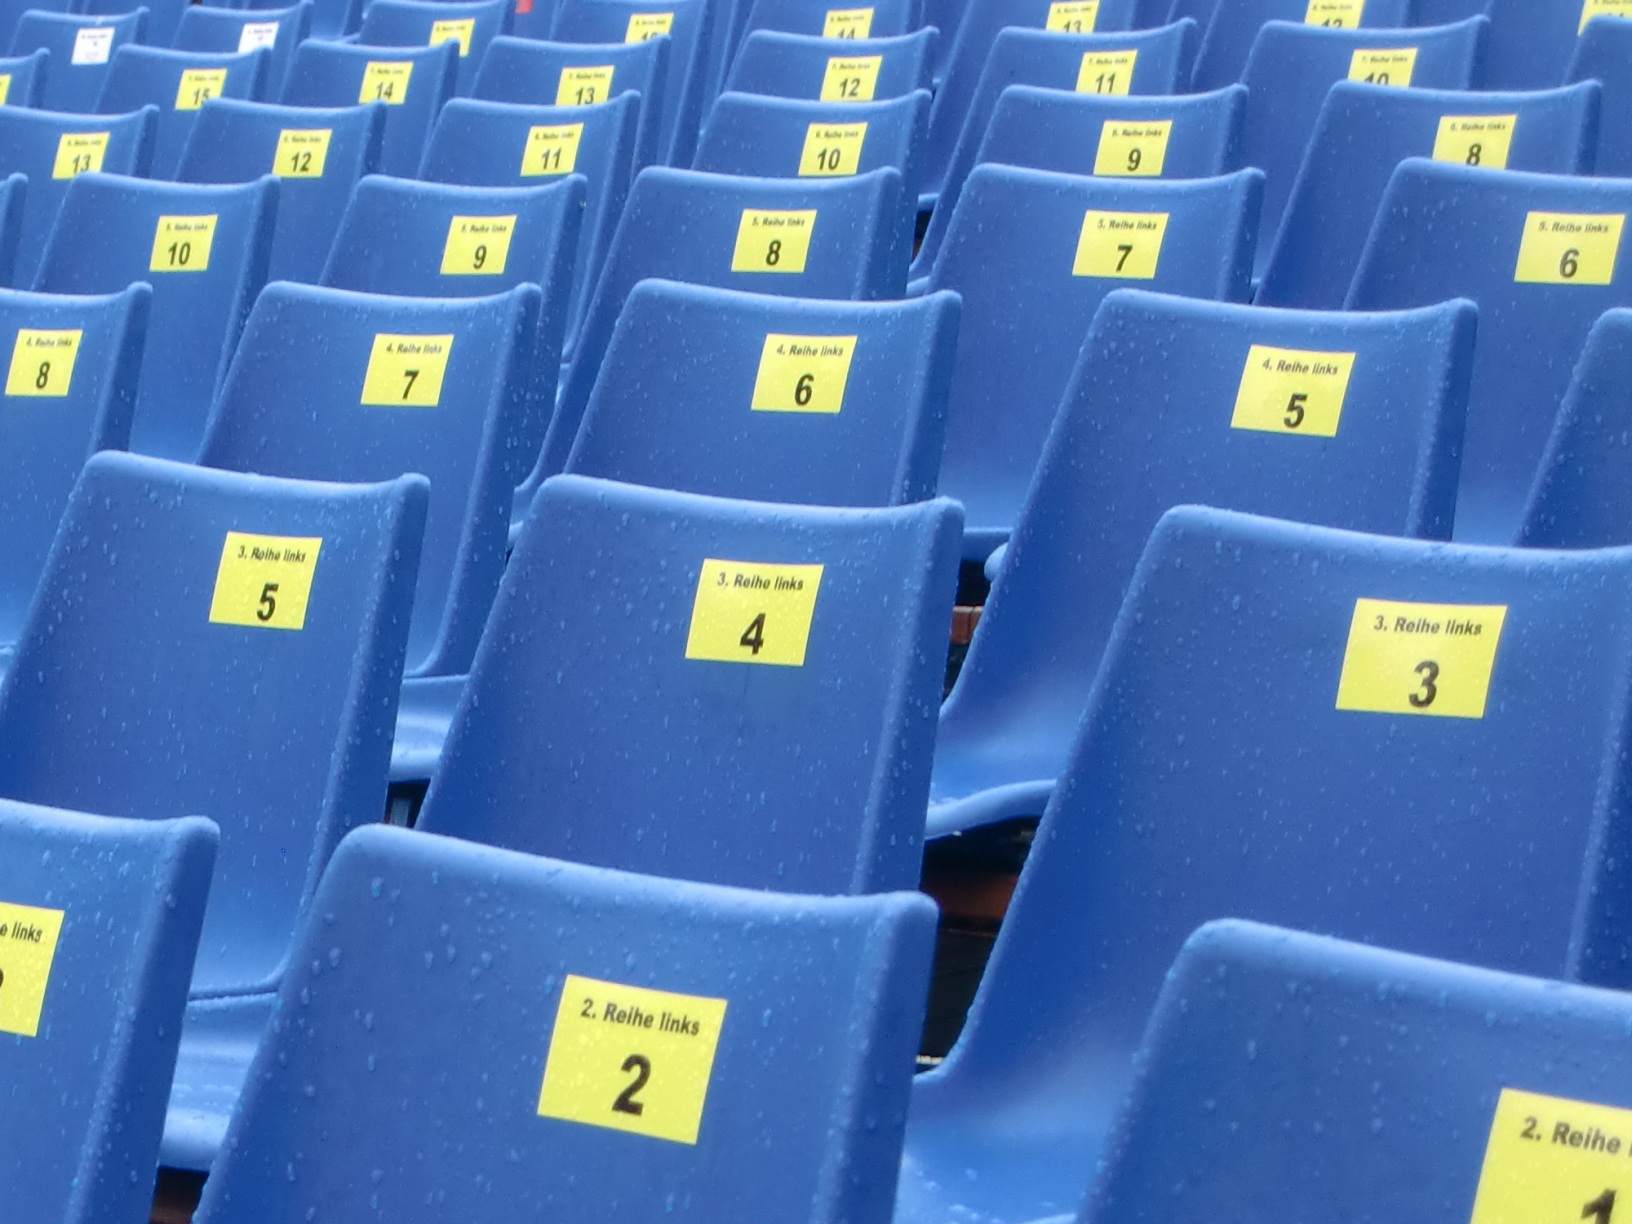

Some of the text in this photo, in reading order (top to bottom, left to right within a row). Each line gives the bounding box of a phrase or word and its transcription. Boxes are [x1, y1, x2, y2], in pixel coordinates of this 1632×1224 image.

[376, 81, 394, 100] 14
[839, 77, 860, 98] 12
[1096, 72, 1116, 93] 11
[193, 88, 209, 105] 15
[576, 87, 595, 105] 13
[72, 154, 91, 174] 13
[291, 151, 312, 173] 12
[541, 147, 562, 170] 11
[817, 148, 841, 171] 10
[1126, 148, 1142, 172] 9
[1465, 143, 1482, 166] 8
[761, 216, 786, 227] Reihe
[1108, 219, 1135, 230] Reihe
[1136, 220, 1158, 231] links
[1551, 221, 1583, 233] Reihe
[1584, 223, 1609, 234] links
[168, 241, 191, 266] 10
[472, 244, 488, 270] 9
[765, 239, 782, 266] 8
[1115, 244, 1134, 272] 7
[1559, 248, 1580, 279] 6
[396, 342, 422, 355] Reihe
[422, 343, 443, 355] links
[776, 343, 844, 357] 4. Reihe links
[35, 361, 51, 390] 8
[1262, 358, 1339, 376] 4. Reihe links
[402, 369, 420, 400] 7
[794, 373, 815, 407] 6
[1283, 393, 1308, 429] 5
[237, 544, 307, 563] 3. Reihe links
[717, 571, 804, 591] 3. Reihe links
[256, 582, 279, 622] 5
[739, 612, 766, 656] 4
[1373, 614, 1483, 636] 3. Reihe links
[1408, 660, 1440, 709] 3
[10, 921, 43, 944] links
[580, 997, 700, 1037] 2. Reihe links
[611, 1054, 651, 1116] 2
[1521, 1116, 1620, 1156] 2. Reihe
